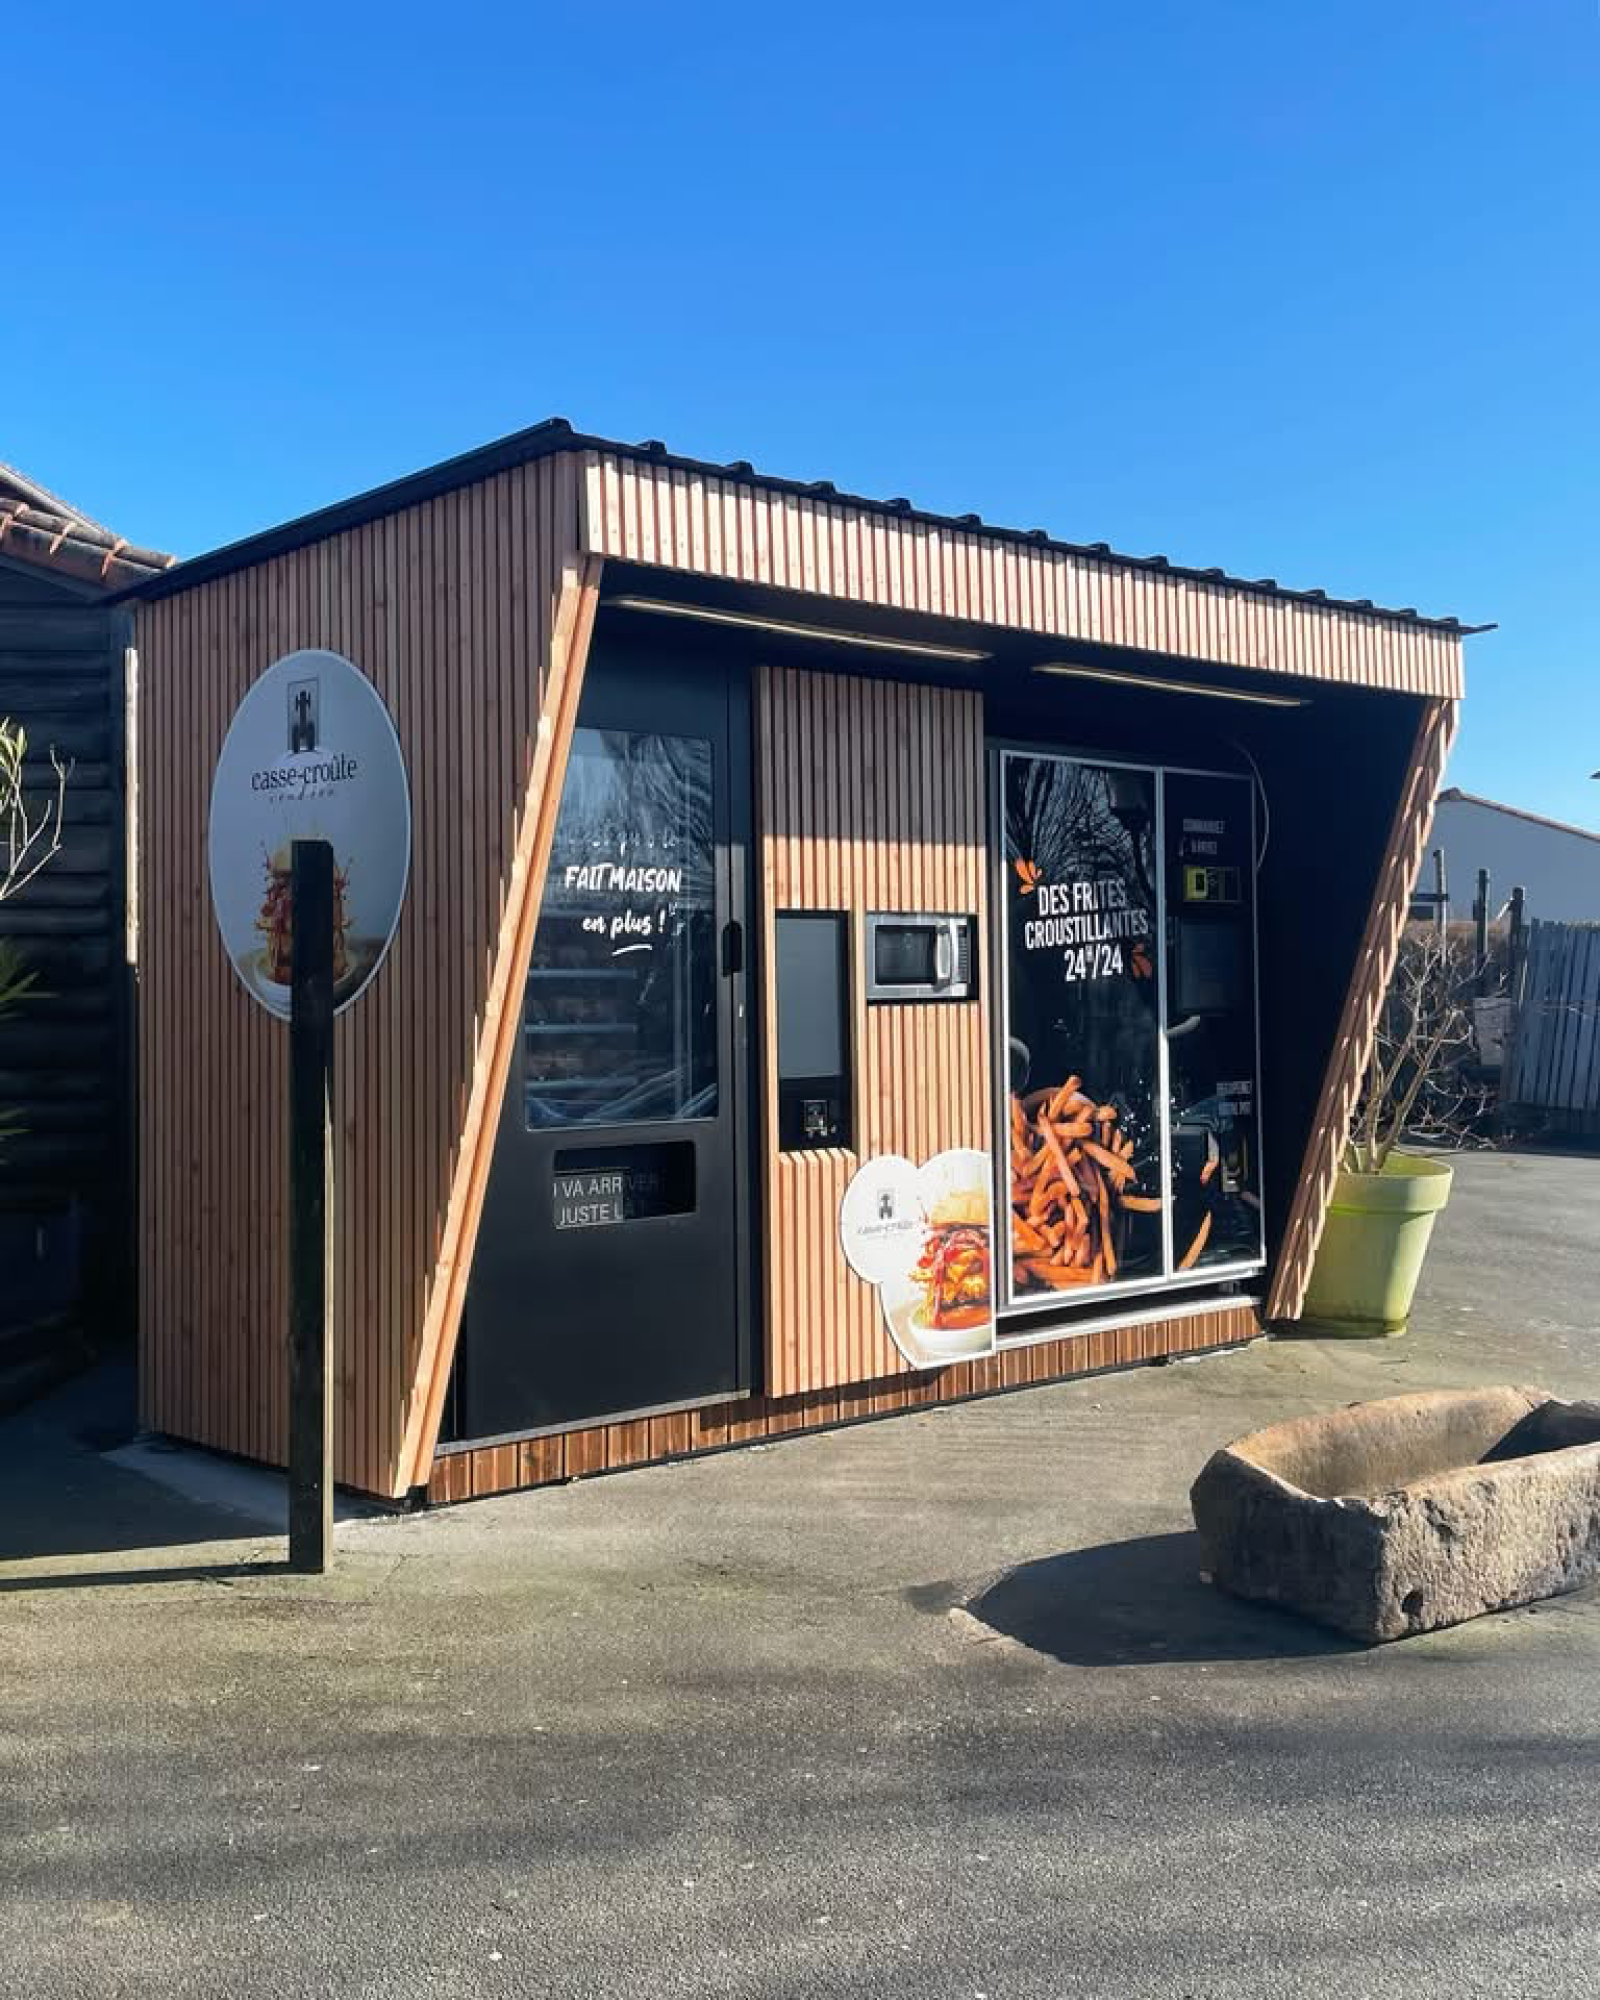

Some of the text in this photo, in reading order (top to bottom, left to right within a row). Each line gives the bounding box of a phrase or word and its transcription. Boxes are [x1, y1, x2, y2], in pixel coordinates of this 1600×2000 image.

[251, 752, 358, 791] casse-croûte
[564, 862, 682, 893] FAIT MAISON
[1038, 877, 1127, 916] DES FRITES
[582, 908, 666, 941] en plus !
[1024, 907, 1149, 951] CROUSTILLANTES
[562, 1179, 584, 1198] VA
[560, 1203, 610, 1226] JUSTE
